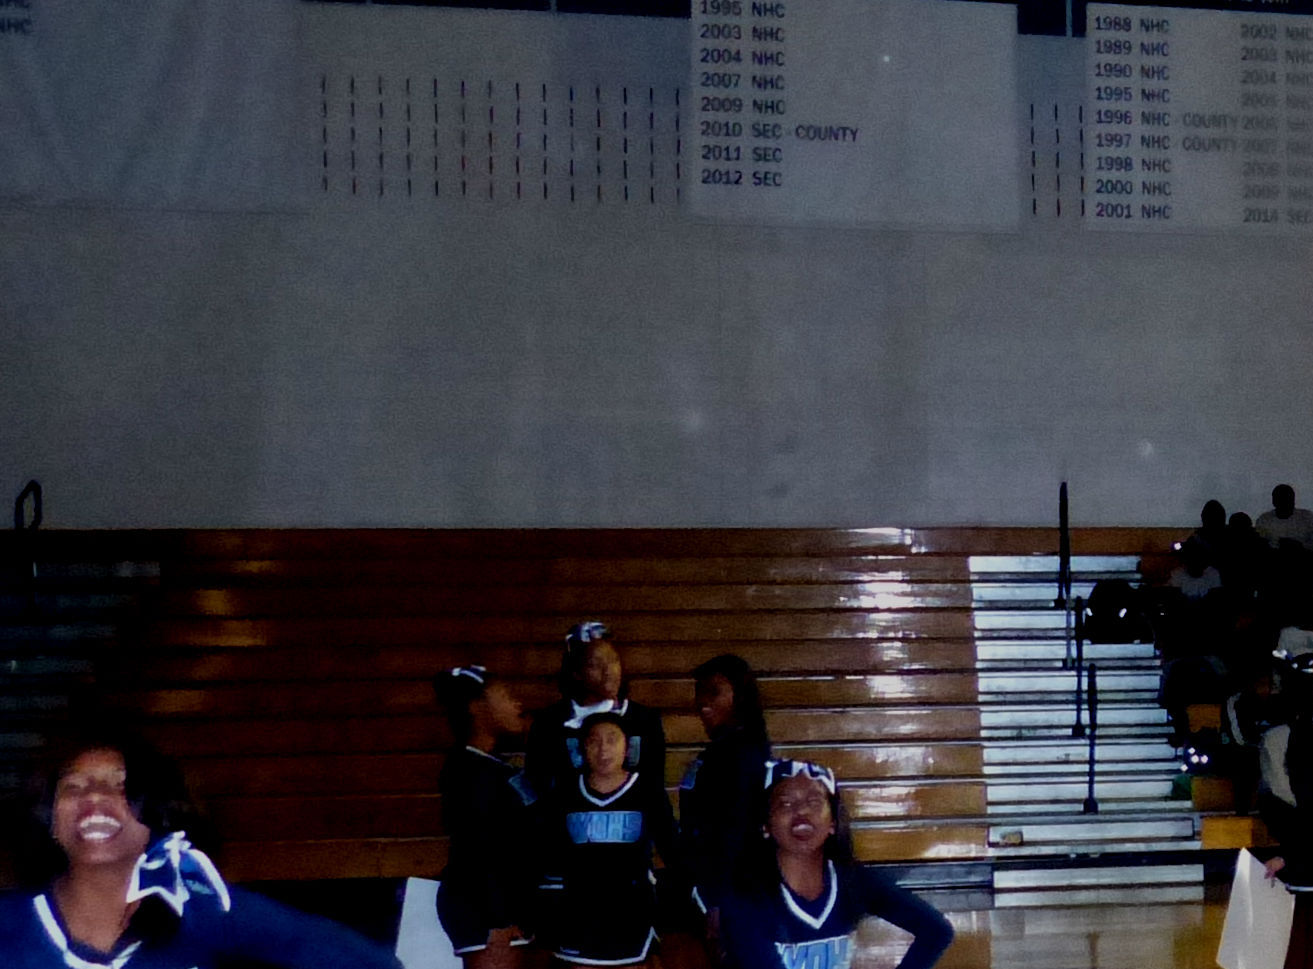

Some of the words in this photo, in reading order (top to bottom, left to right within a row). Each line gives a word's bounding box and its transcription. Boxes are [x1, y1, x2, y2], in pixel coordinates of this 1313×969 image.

[751, 1, 785, 18] NHC
[700, 24, 742, 40] 2003
[751, 26, 785, 42] NHC
[1095, 16, 1133, 32] 1988
[1140, 18, 1171, 33] NHC
[700, 48, 742, 64] 2004
[751, 51, 785, 66] NHC
[1095, 40, 1133, 54] 1989
[1140, 42, 1171, 57] NHC
[700, 72, 742, 88] 2007
[751, 75, 785, 90] NHC
[1140, 65, 1171, 80] NHC
[1095, 87, 1133, 101] 1995
[1140, 88, 1171, 103] NHC
[700, 97, 742, 113] 2009
[751, 99, 785, 115] NHC
[1095, 110, 1133, 125] 1996
[1140, 111, 1171, 126] NHC
[700, 121, 742, 137] 2010
[751, 123, 782, 139] SEC
[795, 124, 858, 142] COUNTY
[1095, 133, 1133, 148] 1997
[1140, 135, 1171, 150] NHC
[701, 145, 741, 161] 2011
[752, 147, 782, 163] SEC
[1095, 156, 1133, 171] 1998
[1140, 158, 1171, 173] NHC
[701, 169, 743, 185] 2012
[752, 171, 782, 187] SEC
[1095, 179, 1133, 194] 2000
[1140, 181, 1171, 196] NHC
[1095, 202, 1133, 218] 2001
[1140, 204, 1171, 219] NHC
[566, 811, 642, 843] WOHS
